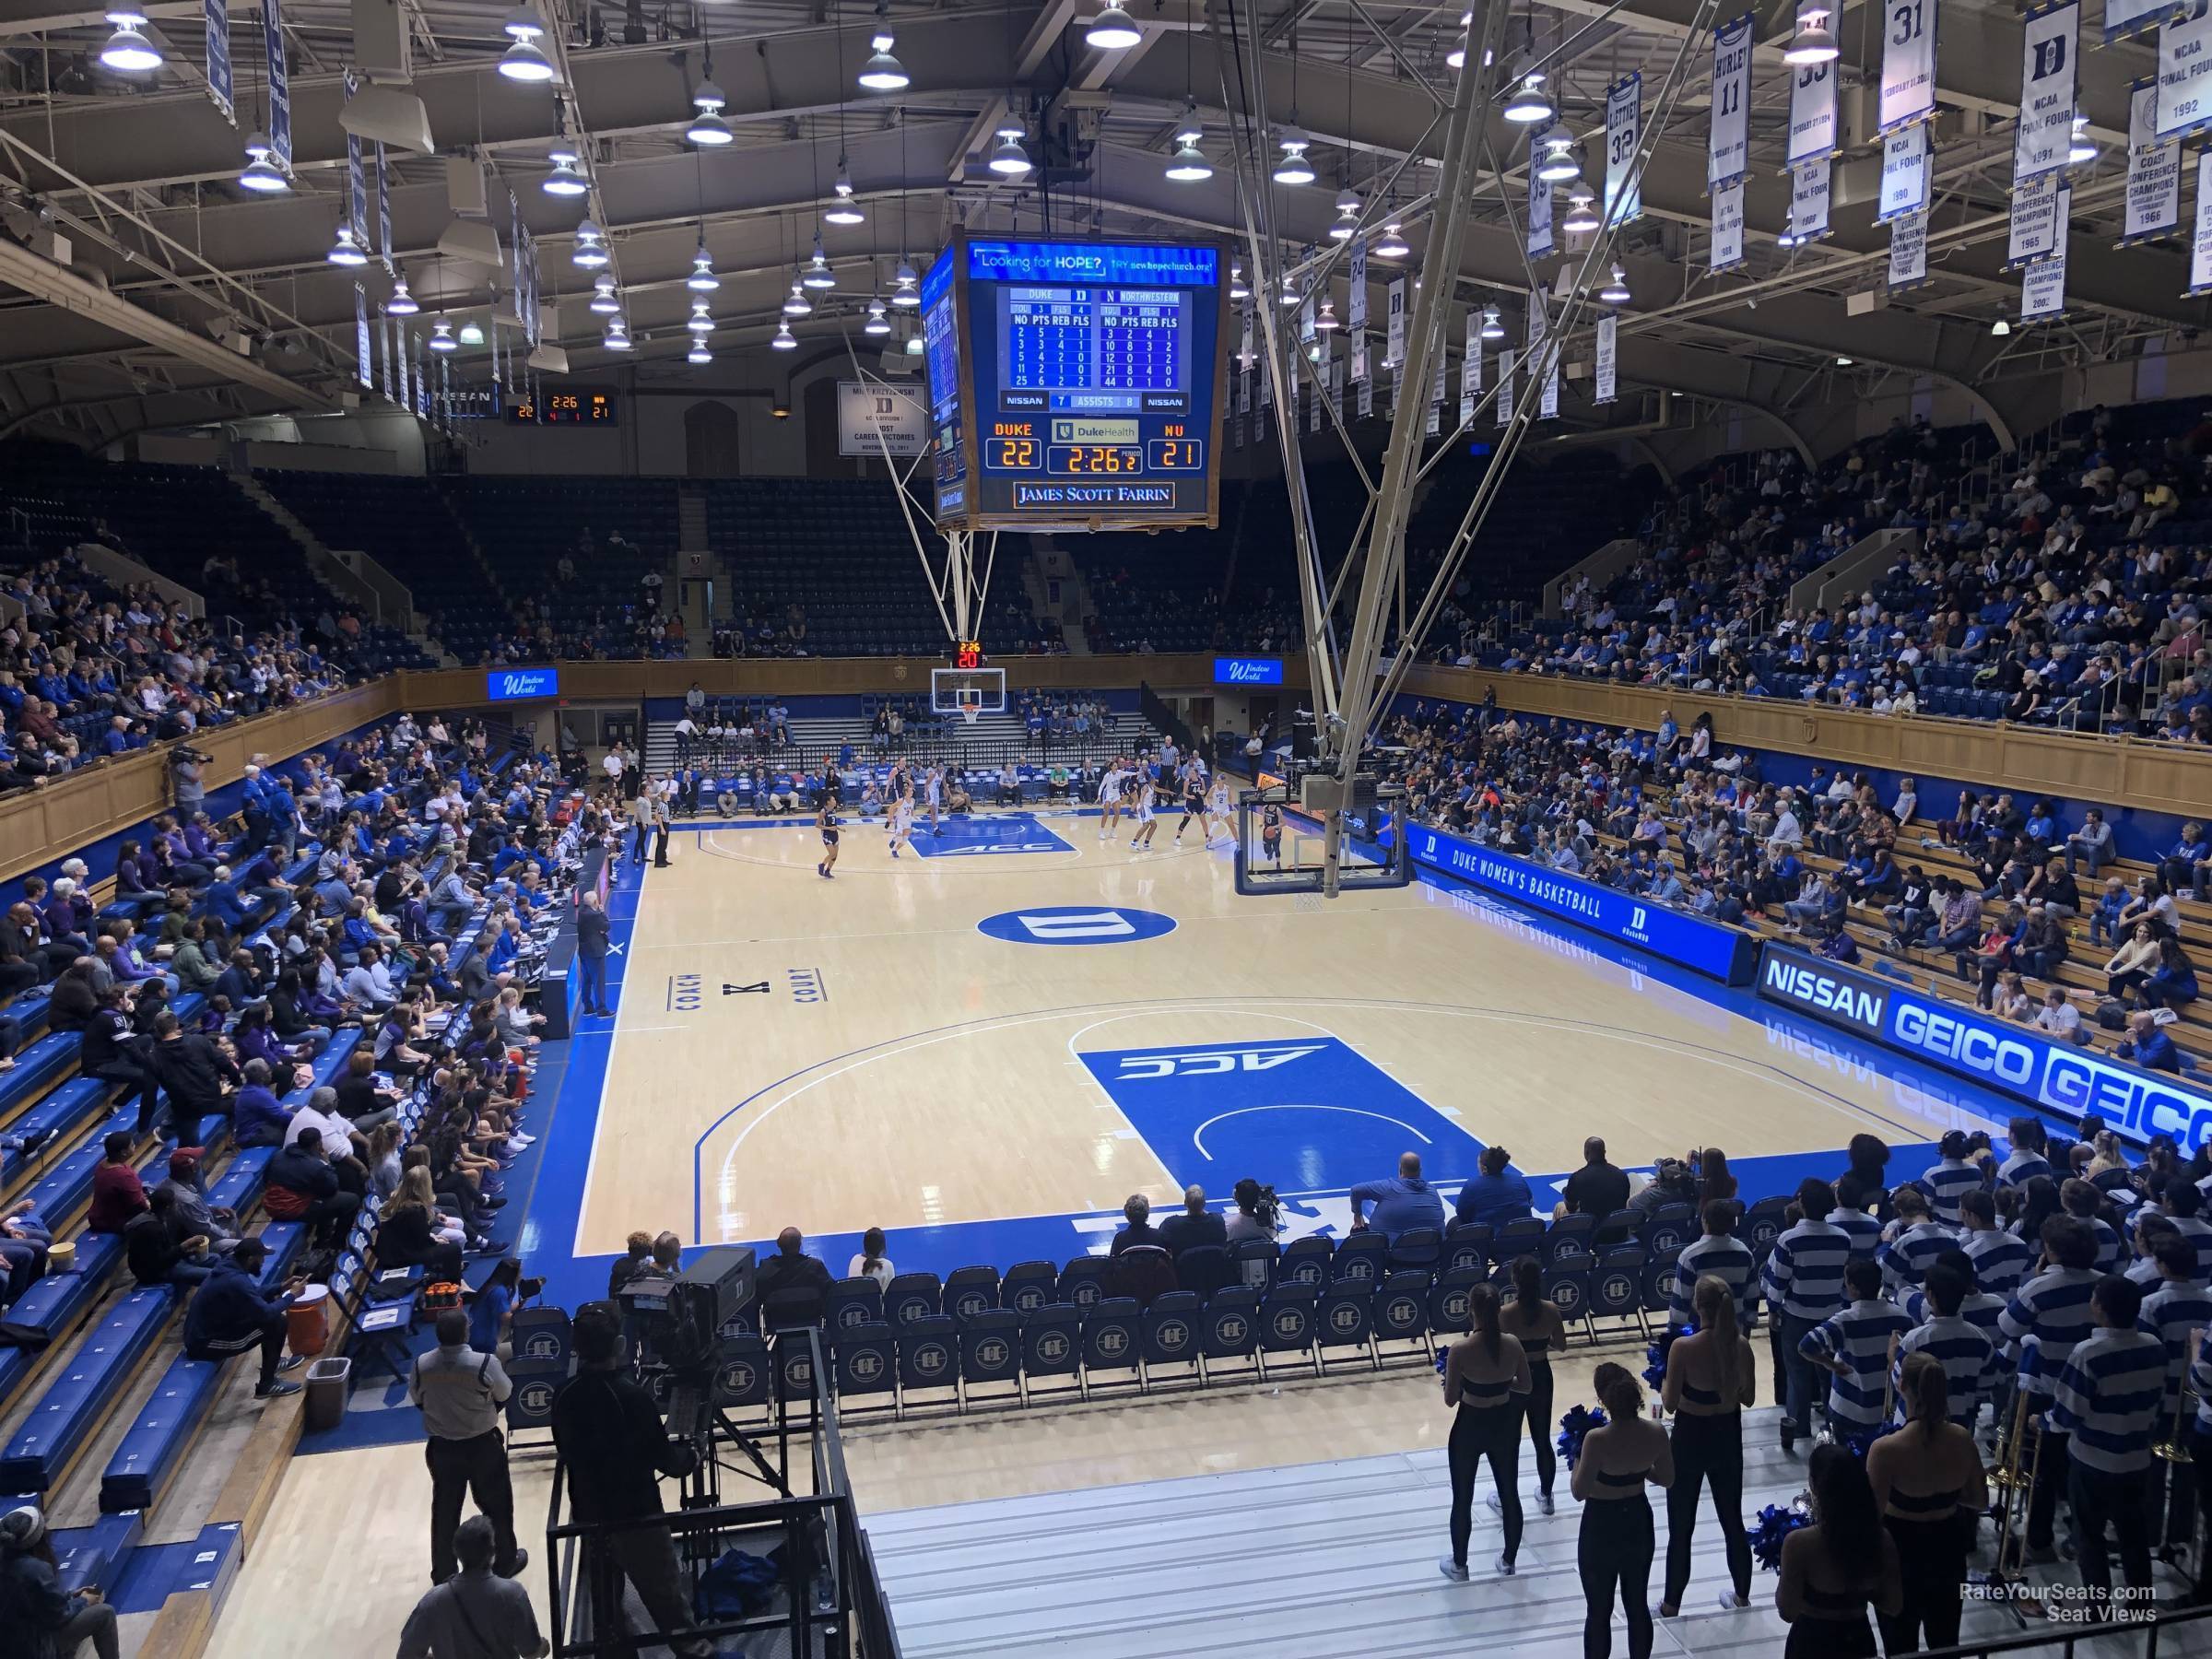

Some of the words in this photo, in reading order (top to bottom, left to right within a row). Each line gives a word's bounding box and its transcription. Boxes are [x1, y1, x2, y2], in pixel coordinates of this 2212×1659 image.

[1893, 0, 1922, 46] 31
[2174, 40, 2202, 60] NCAA
[2160, 69, 2188, 89] FINAL
[1721, 79, 1739, 117] 11
[2034, 93, 2058, 111] NCAA
[2173, 99, 2199, 118] 1992
[2045, 110, 2071, 128] FOUR
[1612, 129, 1633, 165] 32
[1891, 139, 1909, 154] NCAA
[1900, 154, 1922, 169] FOUR
[2140, 153, 2166, 169] COAST
[1804, 168, 1818, 182] NCAA
[2129, 162, 2177, 184] CONFERENCE
[1810, 183, 1828, 197] FOUR
[2022, 184, 2044, 199] COAST
[2129, 177, 2174, 198] CHAMPIONS
[2013, 193, 2054, 214] CONFERENCE
[2013, 206, 2053, 226] CHAMPIONS
[2139, 211, 2161, 225] 1966
[2021, 236, 2040, 250] 1965
[982, 254, 1030, 272] Looking
[1033, 255, 1052, 267] for
[1055, 257, 1101, 268] HOPE?
[1130, 262, 1213, 273] newhopechurch.org!
[2026, 259, 2065, 276] CONFERENCE
[2027, 271, 2063, 287] CHAMPIONS
[1029, 289, 1053, 299] DUKE
[1107, 290, 1114, 302] N
[1120, 291, 1180, 303] NORTHWESTERN
[1078, 306, 1084, 314] 4
[1127, 307, 1133, 315] 3
[1015, 315, 1028, 324] NO
[1032, 315, 1050, 325] PTS
[1053, 315, 1070, 325] REB
[1073, 316, 1089, 326] FLS
[1104, 317, 1117, 326] NO
[1122, 317, 1139, 327] PTS
[1141, 317, 1159, 327] REB
[1161, 318, 1177, 327] FLS
[1018, 327, 1024, 337] 2
[1039, 327, 1044, 337] 5
[1059, 328, 1064, 338] 2
[1108, 329, 1113, 339] 3
[1127, 329, 1133, 339] 2
[1147, 330, 1152, 340] 4
[1018, 339, 1024, 349] 3
[1039, 339, 1044, 349] 3
[1058, 340, 1065, 349] 4
[1106, 341, 1115, 351] 10
[1127, 341, 1133, 351] 8
[1147, 342, 1152, 351] 3
[1166, 342, 1171, 352] 2
[1018, 351, 1024, 361] 5
[1039, 352, 1044, 361] 4
[1059, 352, 1064, 362] 2
[1078, 352, 1084, 362] 0
[1106, 353, 1115, 363] 12
[1127, 353, 1133, 363] 0
[1166, 354, 1171, 364] 2
[1018, 363, 1025, 373] 11
[1039, 364, 1044, 373] 2
[1078, 365, 1084, 374] 0
[1106, 365, 1115, 375] 21
[1127, 365, 1133, 375] 8
[1147, 366, 1152, 376] 4
[1166, 366, 1171, 376] 0
[1016, 375, 1027, 385] 25
[1039, 376, 1044, 385] 6
[1059, 376, 1064, 386] 2
[1078, 376, 1084, 386] 2
[1105, 377, 1116, 387] 44
[1127, 377, 1133, 387] 0
[1166, 378, 1171, 388] 0
[553, 396, 578, 408] 2:26
[1058, 396, 1065, 406] 7
[1077, 396, 1113, 406] ASSISTS
[1127, 397, 1133, 406] 8
[594, 407, 608, 418] 21
[994, 423, 1032, 436] DUKE
[1164, 425, 1183, 437] NU
[1077, 427, 1135, 437] DukeHealth
[1003, 441, 1032, 466] 22
[1069, 448, 1119, 472] 2:26
[1127, 457, 1135, 470] 2
[1163, 442, 1192, 466] 21
[1019, 487, 1064, 503] JAMES
[1066, 487, 1113, 501] SCOTT
[1117, 488, 1171, 501] FARRIN
[960, 642, 981, 653] 2:26
[959, 652, 977, 668] 20
[930, 842, 1057, 855] ACC
[1453, 850, 1477, 872] DUKE
[1479, 859, 1525, 890] WOMEN'S
[1529, 877, 1601, 920] BASKETBALL
[675, 973, 701, 1011] COACH
[787, 968, 820, 1003] COURT
[1766, 959, 1884, 1029] NISSAN
[1894, 1003, 2034, 1086] GEICO
[1114, 1043, 1330, 1080] ACC
